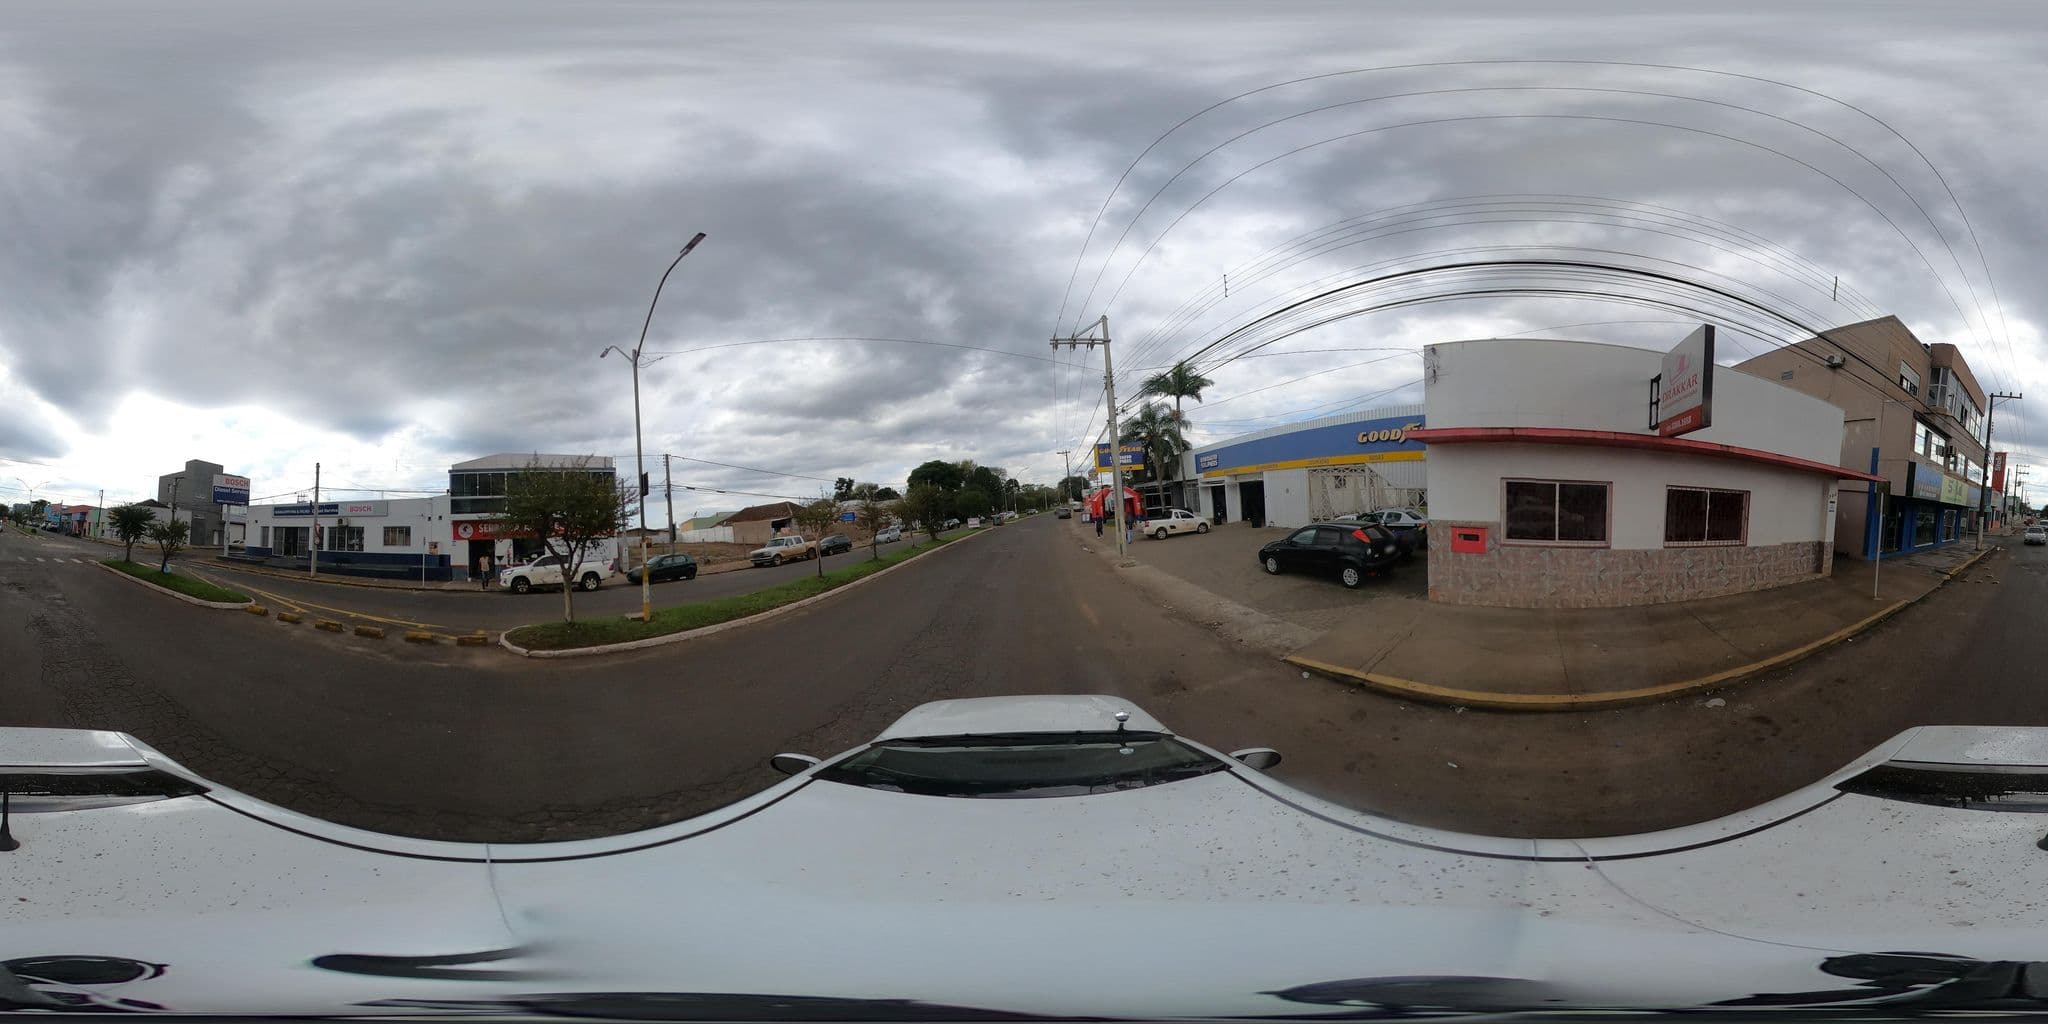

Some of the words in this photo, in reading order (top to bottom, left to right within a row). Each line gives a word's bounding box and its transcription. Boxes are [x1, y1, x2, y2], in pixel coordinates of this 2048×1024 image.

[1662, 374, 1698, 401] DRAKKAR
[225, 478, 249, 487] BOSCH
[349, 505, 372, 513] BOSCH
